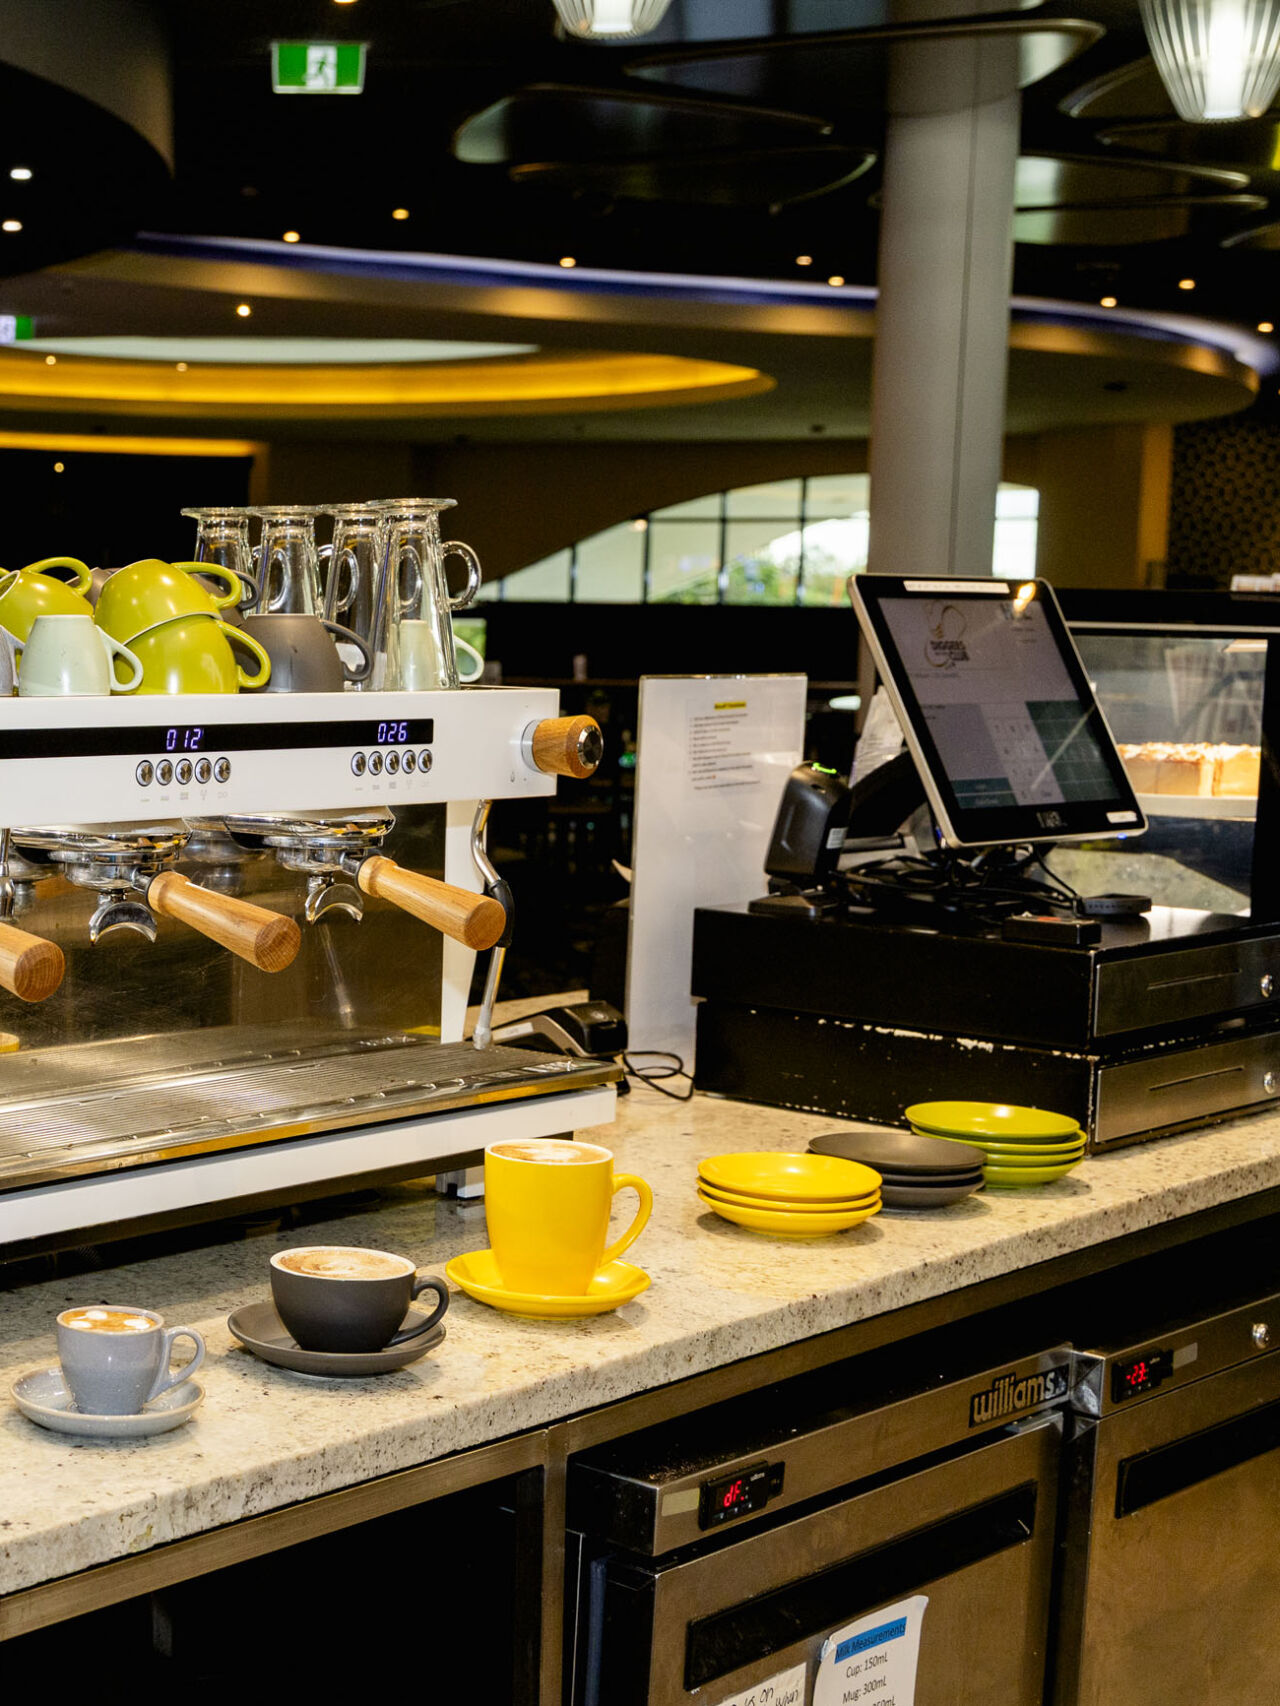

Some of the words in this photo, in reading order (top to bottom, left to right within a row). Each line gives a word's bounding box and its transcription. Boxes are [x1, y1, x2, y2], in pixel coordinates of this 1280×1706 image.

[166, 728, 202, 751] 012
[377, 722, 408, 742] 026
[836, 1644, 850, 1659] Milk
[852, 1624, 906, 1651] Measurements
[846, 1664, 863, 1679] Cup:
[864, 1652, 888, 1671] 150mL
[842, 1689, 862, 1705] Mug:
[863, 1675, 887, 1695] 300mL
